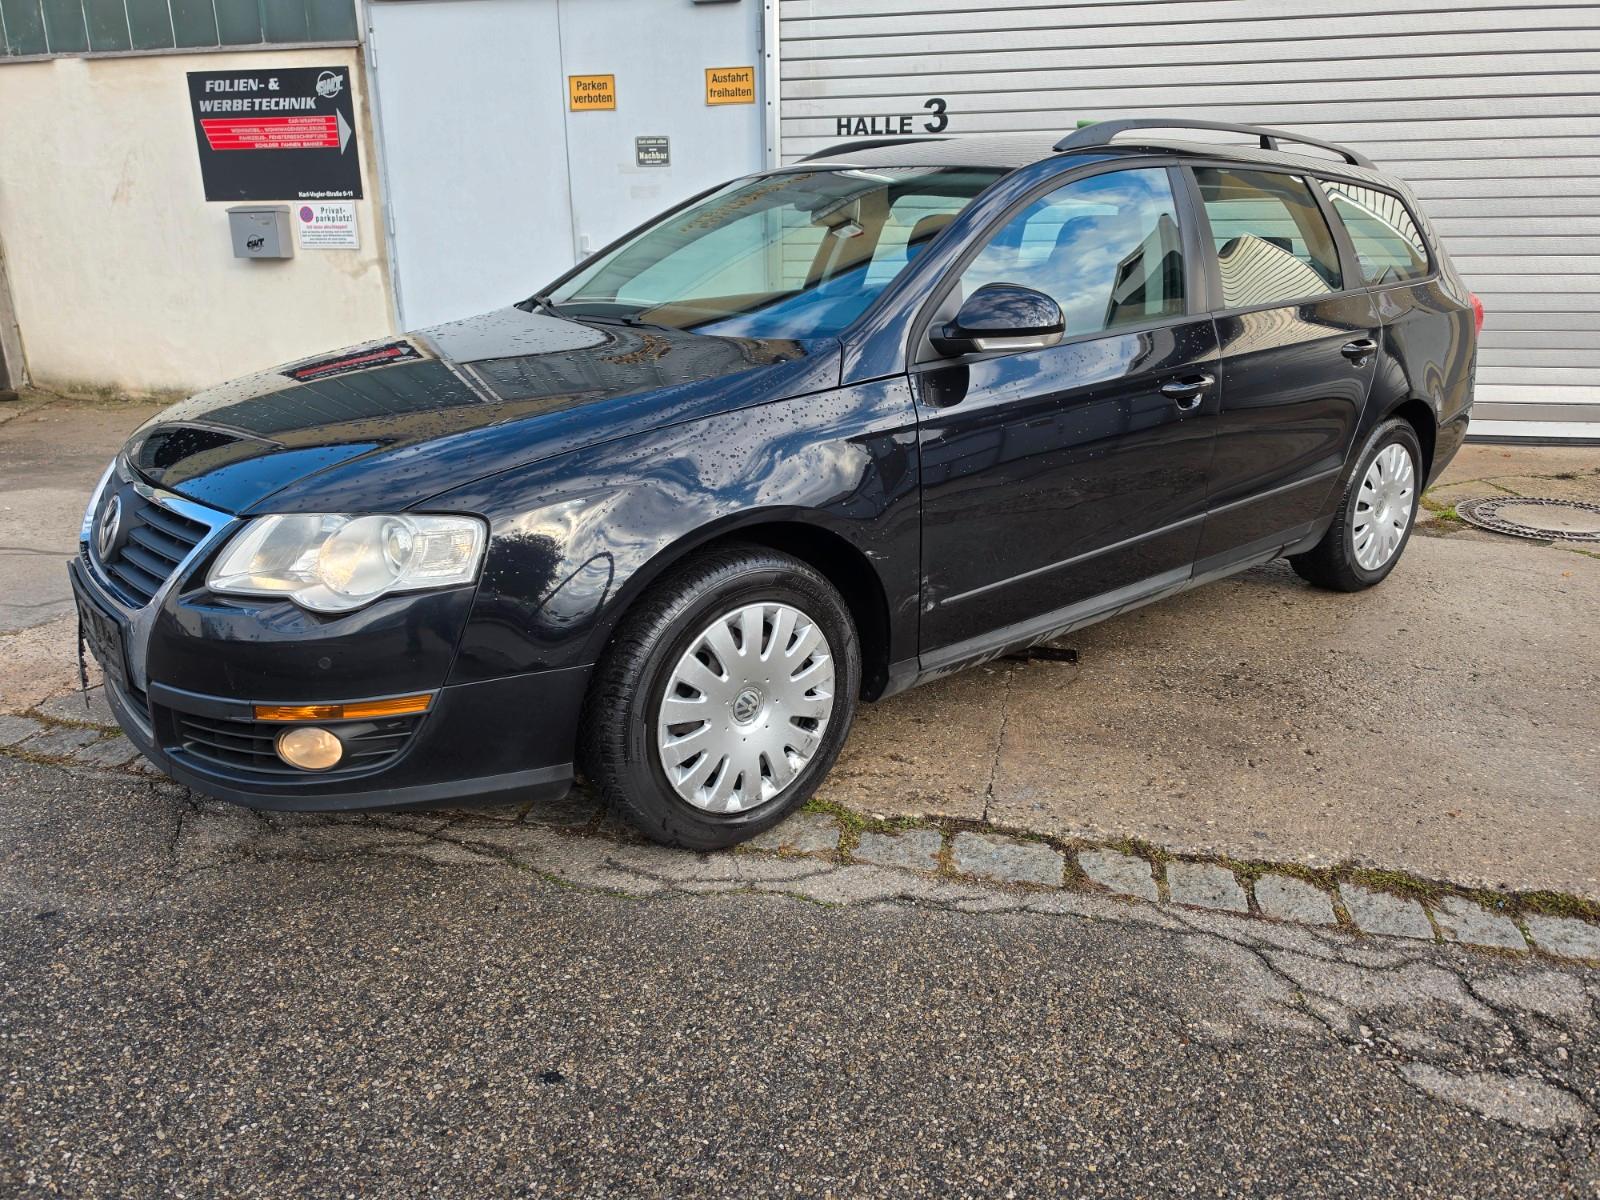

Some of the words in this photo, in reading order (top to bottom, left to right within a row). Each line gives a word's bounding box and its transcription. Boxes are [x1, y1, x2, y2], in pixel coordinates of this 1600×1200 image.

[711, 72, 749, 83] Ausfahrt
[205, 79, 265, 93] FOLIEN-
[268, 78, 280, 91] &
[576, 81, 608, 91] Parken
[710, 87, 752, 98] freihalten
[573, 93, 613, 104] verboten
[199, 97, 317, 112] WERBETECHNIK
[836, 116, 913, 136] HALLE
[923, 97, 949, 133] 3
[639, 151, 668, 160] Nachbar
